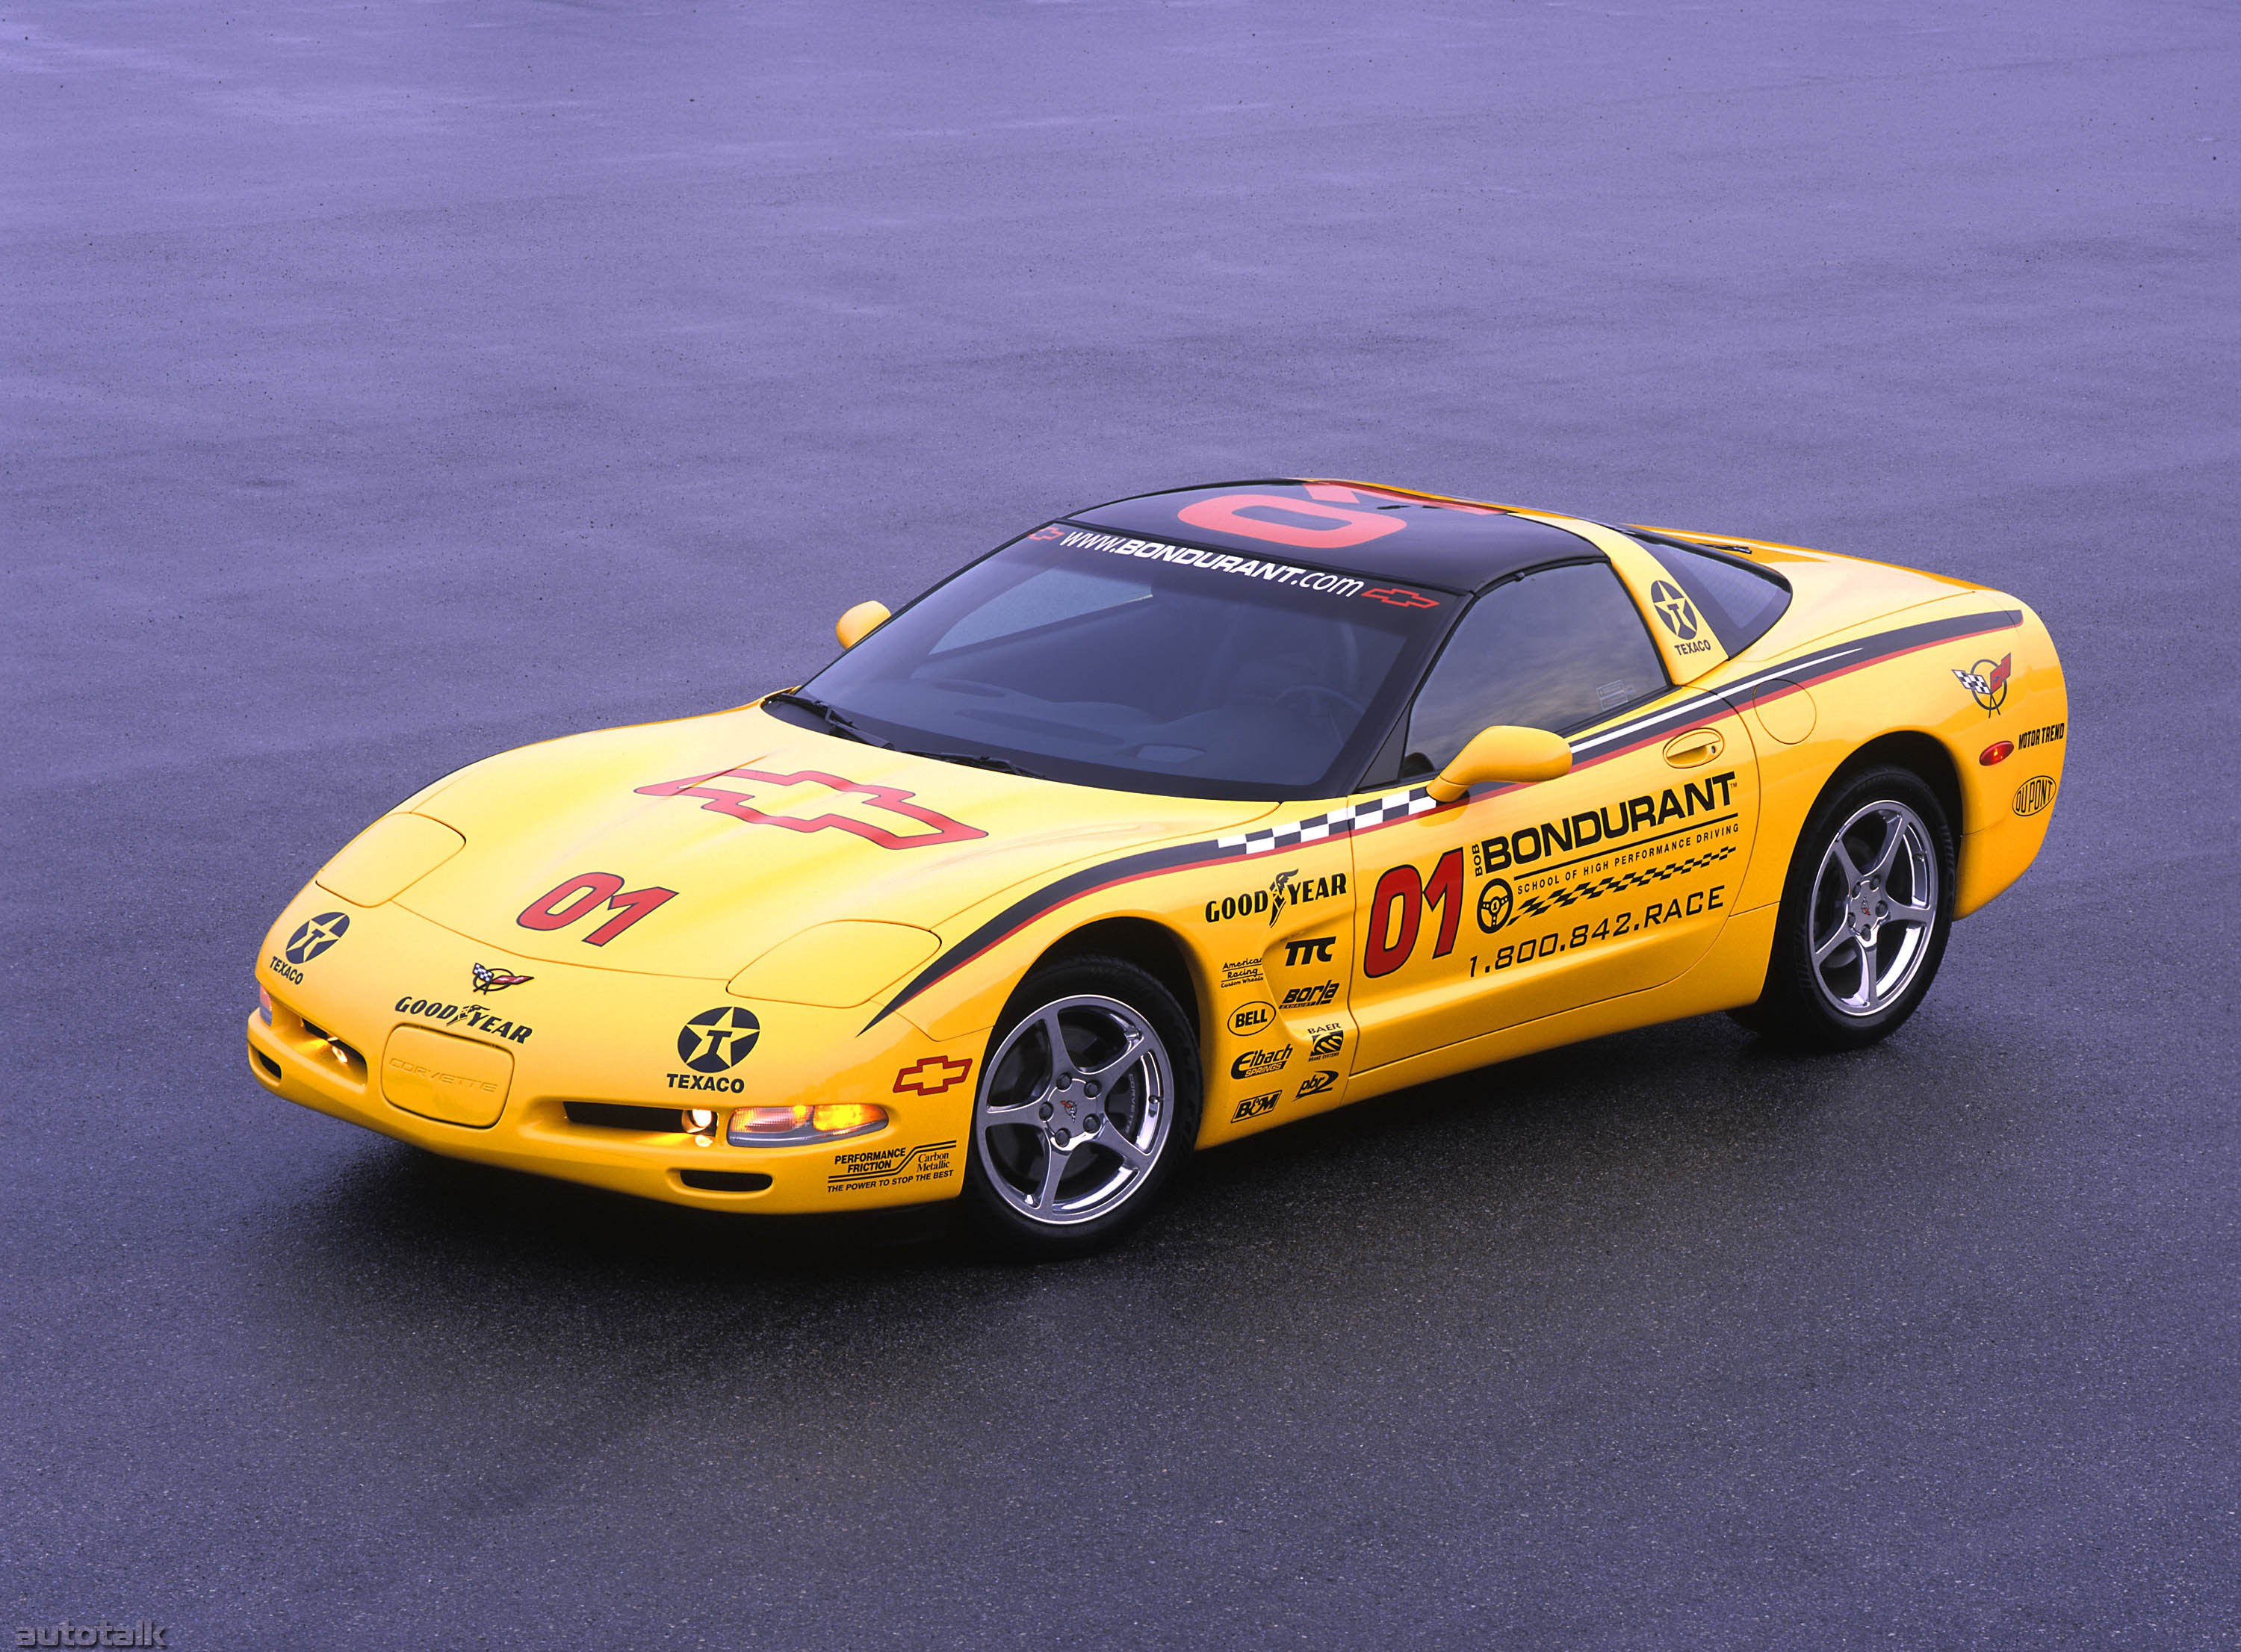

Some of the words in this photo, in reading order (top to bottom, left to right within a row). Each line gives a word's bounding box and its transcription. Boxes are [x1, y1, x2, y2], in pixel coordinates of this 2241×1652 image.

[1059, 530, 1364, 597] www.BONDURANT.com
[1674, 639, 1711, 656] TEXACO
[2018, 729, 2041, 751] MOTOR
[2042, 722, 2065, 744] TREND
[1481, 771, 1735, 875] BONDURANT
[1472, 843, 1483, 877] BOB
[1517, 876, 1560, 895] SCHOOL
[1565, 866, 1578, 881] OF
[1584, 860, 1609, 876] HIGH
[1614, 837, 1691, 866] PERFORMANCE
[1696, 823, 1739, 842] DRIVING
[516, 872, 680, 948] 01
[1363, 846, 1464, 979] 01
[1469, 884, 1725, 978] 1.800.842.RACE
[1285, 936, 1337, 966] TTC
[270, 956, 304, 985] TEXACO
[1227, 968, 1258, 978] Racing
[1235, 1008, 1268, 1028] BELL
[1307, 1022, 1342, 1034] BAER
[388, 1058, 498, 1093] CORVETTE
[1231, 1043, 1293, 1080] Eibach
[1245, 1062, 1283, 1077] SPRINGS
[666, 1073, 745, 1093] TEXACO
[834, 1147, 906, 1165] PERFORMANCE
[847, 1159, 892, 1173] FRICTION
[917, 1160, 950, 1173] Metallic
[918, 1152, 949, 1164] Carbon
[827, 1184, 844, 1193] THE
[846, 1180, 877, 1191] POWER
[879, 1178, 890, 1187] TO
[892, 1175, 914, 1185] STOP
[916, 1173, 932, 1181] THE
[933, 1170, 955, 1179] BEST
